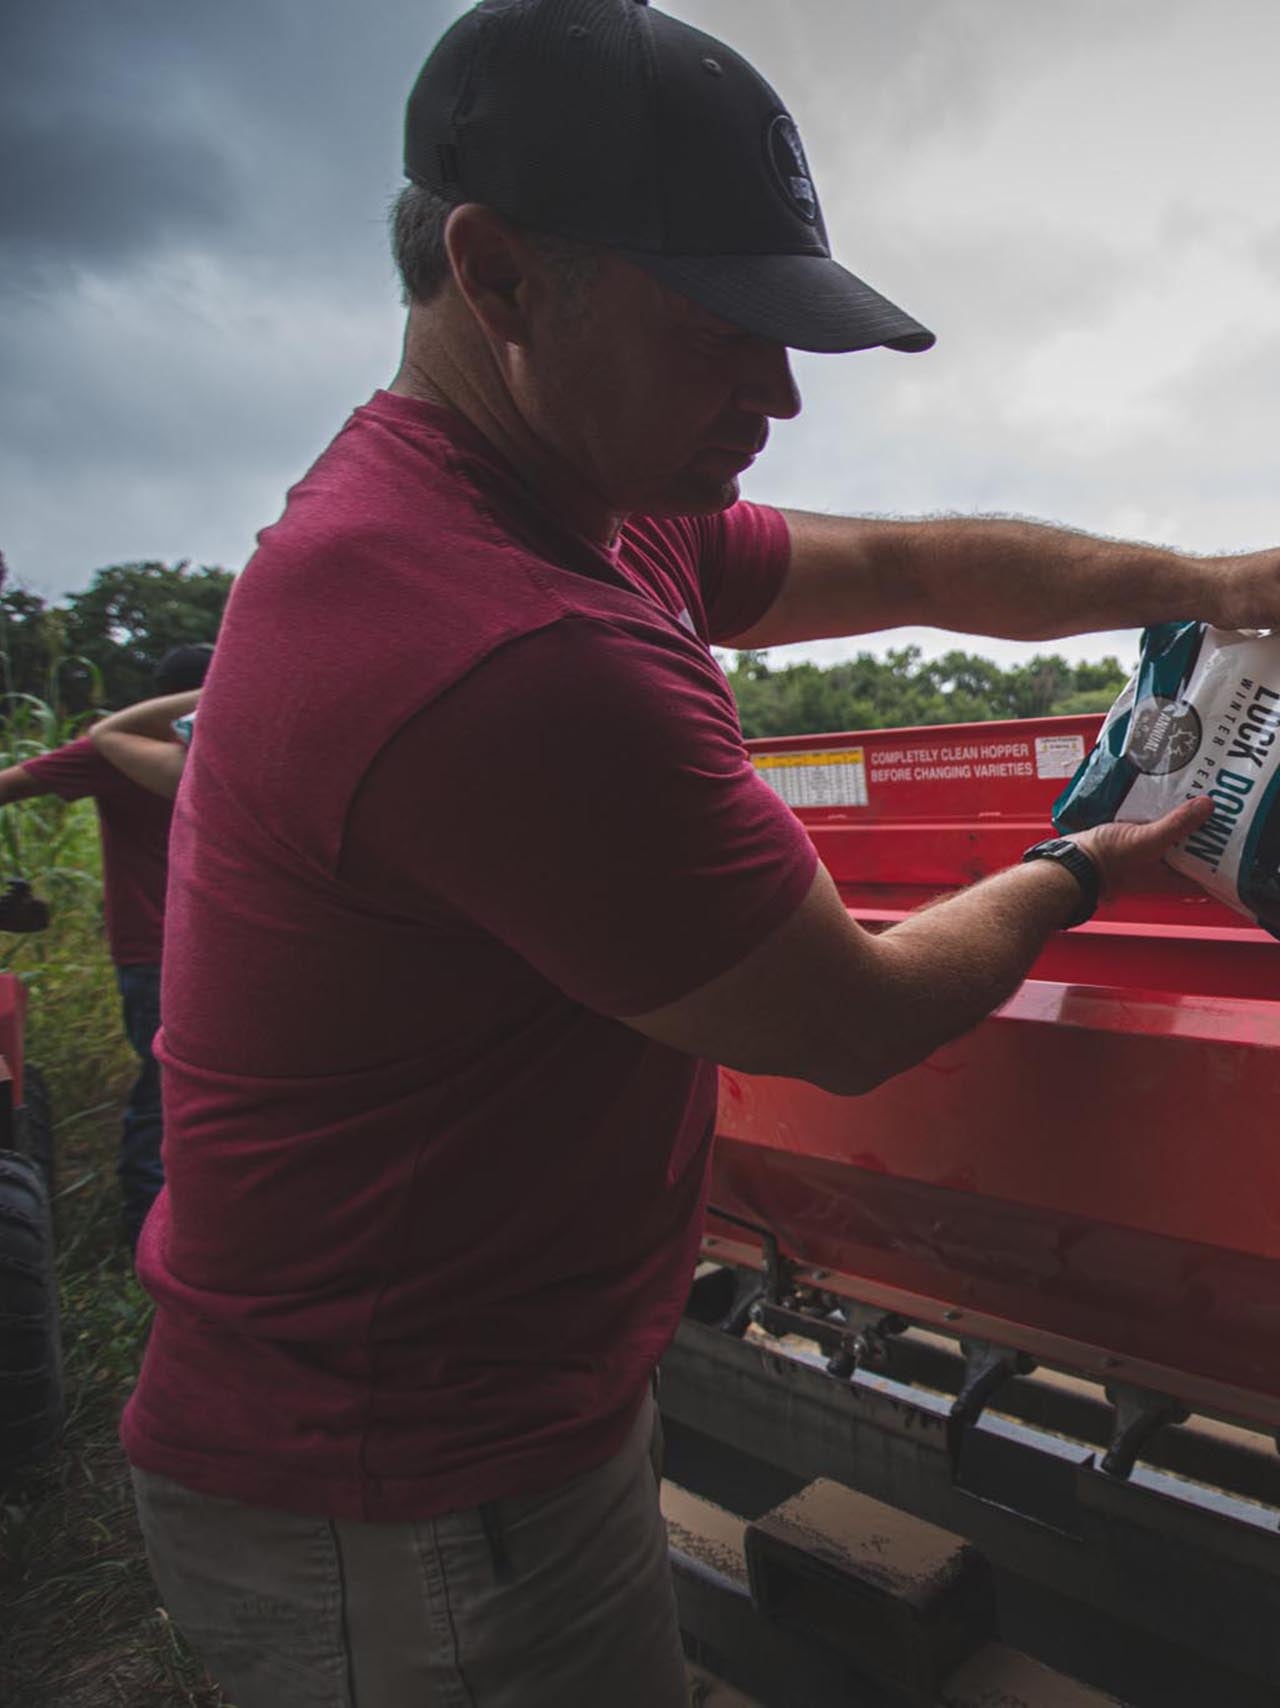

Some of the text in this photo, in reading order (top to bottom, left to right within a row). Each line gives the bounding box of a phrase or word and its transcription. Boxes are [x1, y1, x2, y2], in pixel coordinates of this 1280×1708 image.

[1143, 711, 1171, 752] ANNUAL
[1212, 678, 1253, 746] WINTER
[870, 744, 1029, 765] COMPLETELY CLEAN HOPPER
[871, 768, 912, 782] BEFORE
[914, 765, 970, 780] CHANGING
[973, 762, 1033, 777] VARIETIES
[1184, 768, 1255, 866] DOWN
